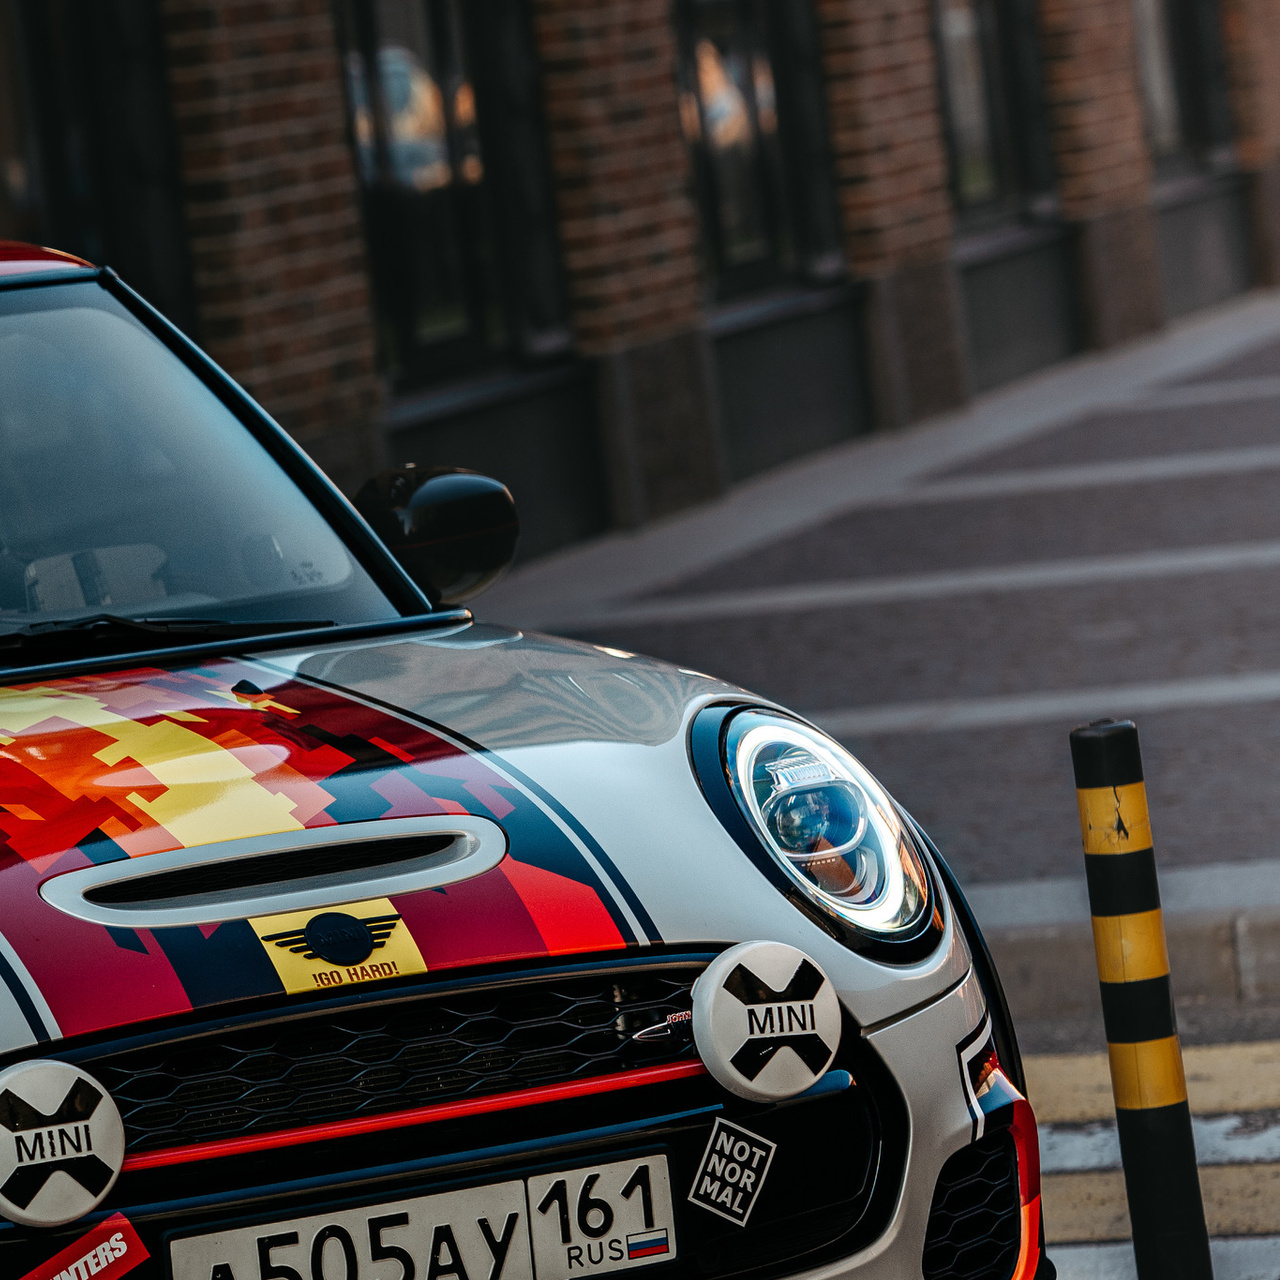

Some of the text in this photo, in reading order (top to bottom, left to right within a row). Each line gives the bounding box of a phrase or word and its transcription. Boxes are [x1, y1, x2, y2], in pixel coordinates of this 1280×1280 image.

[315, 925, 365, 947] MINI
[346, 961, 400, 982] HARD!
[667, 1010, 691, 1024] JOHN
[747, 1003, 816, 1035] MINI
[14, 1124, 93, 1163] MINI
[715, 1131, 766, 1168] NOT
[706, 1153, 756, 1193] NOR
[536, 1164, 655, 1244] 161
[699, 1175, 743, 1214] MAL
[567, 1238, 624, 1270] RUS
